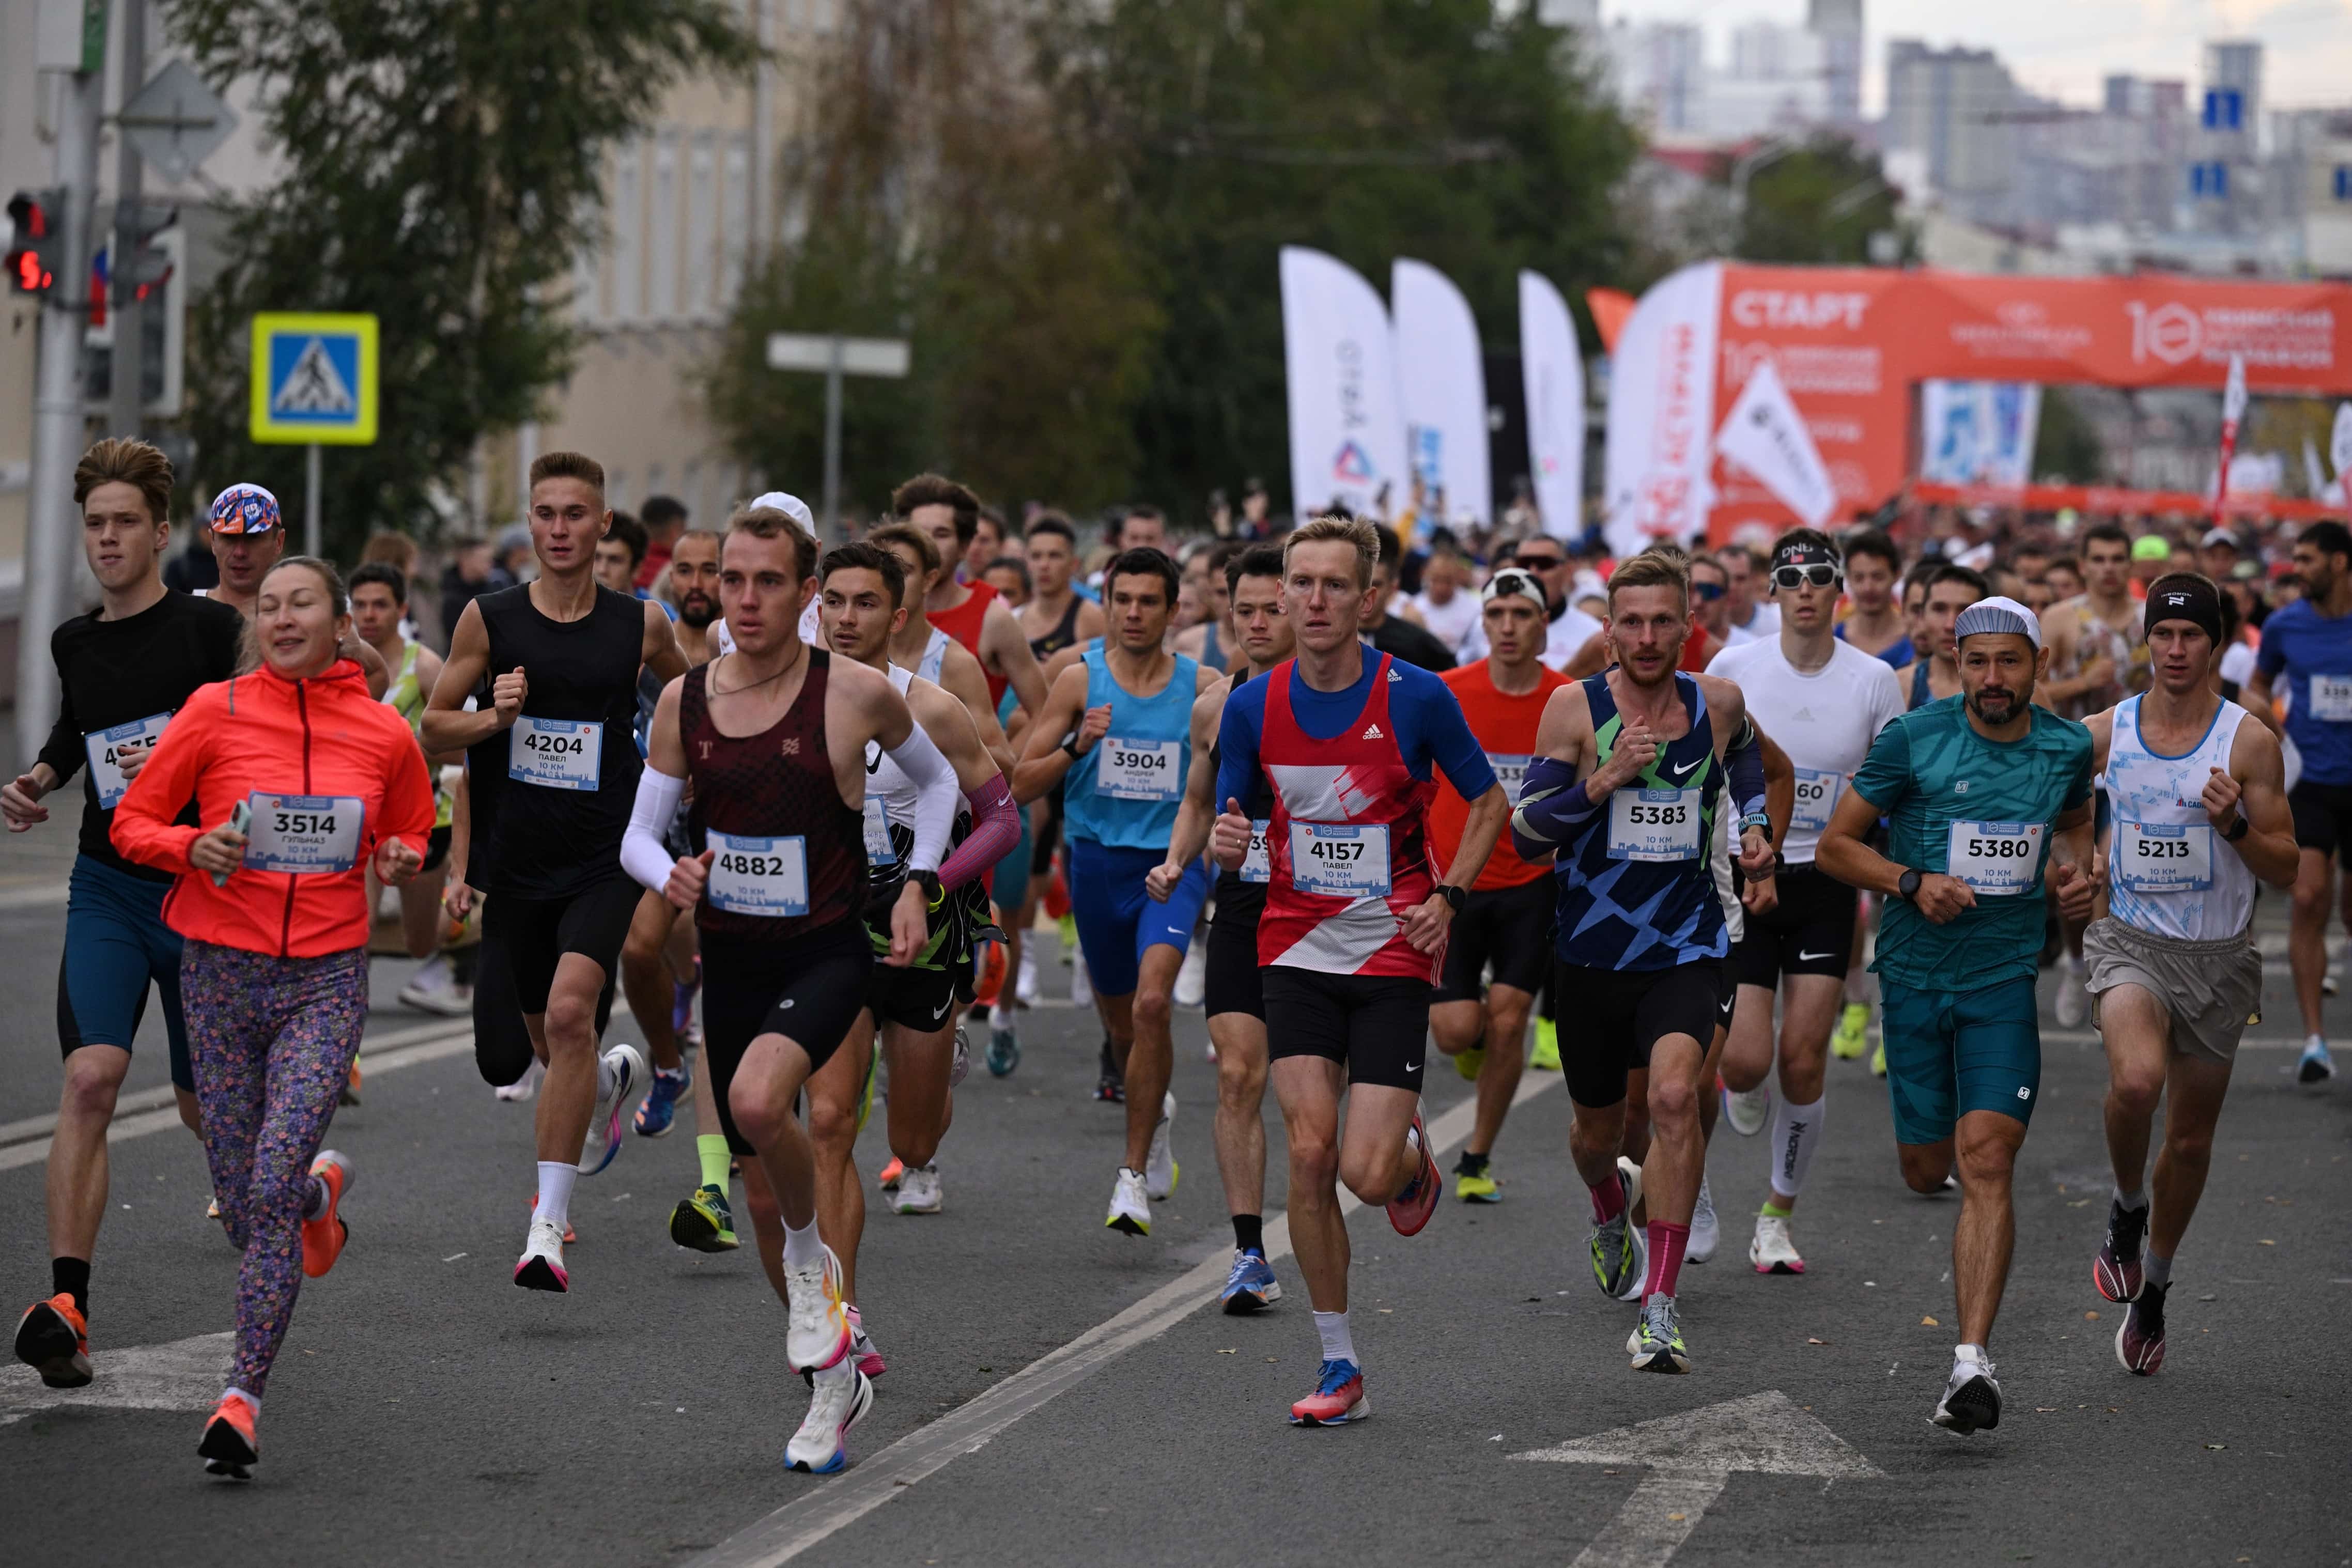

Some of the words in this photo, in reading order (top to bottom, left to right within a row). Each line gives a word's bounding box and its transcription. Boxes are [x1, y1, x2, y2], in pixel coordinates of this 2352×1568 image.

[1730, 289, 1871, 330] СТАРТ
[524, 734, 583, 754] 4204
[538, 753, 566, 762] ПАВЕЛ
[1113, 751, 1166, 769] 3904
[1797, 783, 1823, 800] 60
[273, 813, 336, 834] 3514
[1630, 805, 1686, 825] 5383
[282, 835, 326, 844] ГУЛЬНАЗ
[1968, 839, 2029, 858] 5380
[1310, 842, 1365, 860] 4157
[2138, 840, 2189, 858] 5213
[720, 853, 783, 876] 4882
